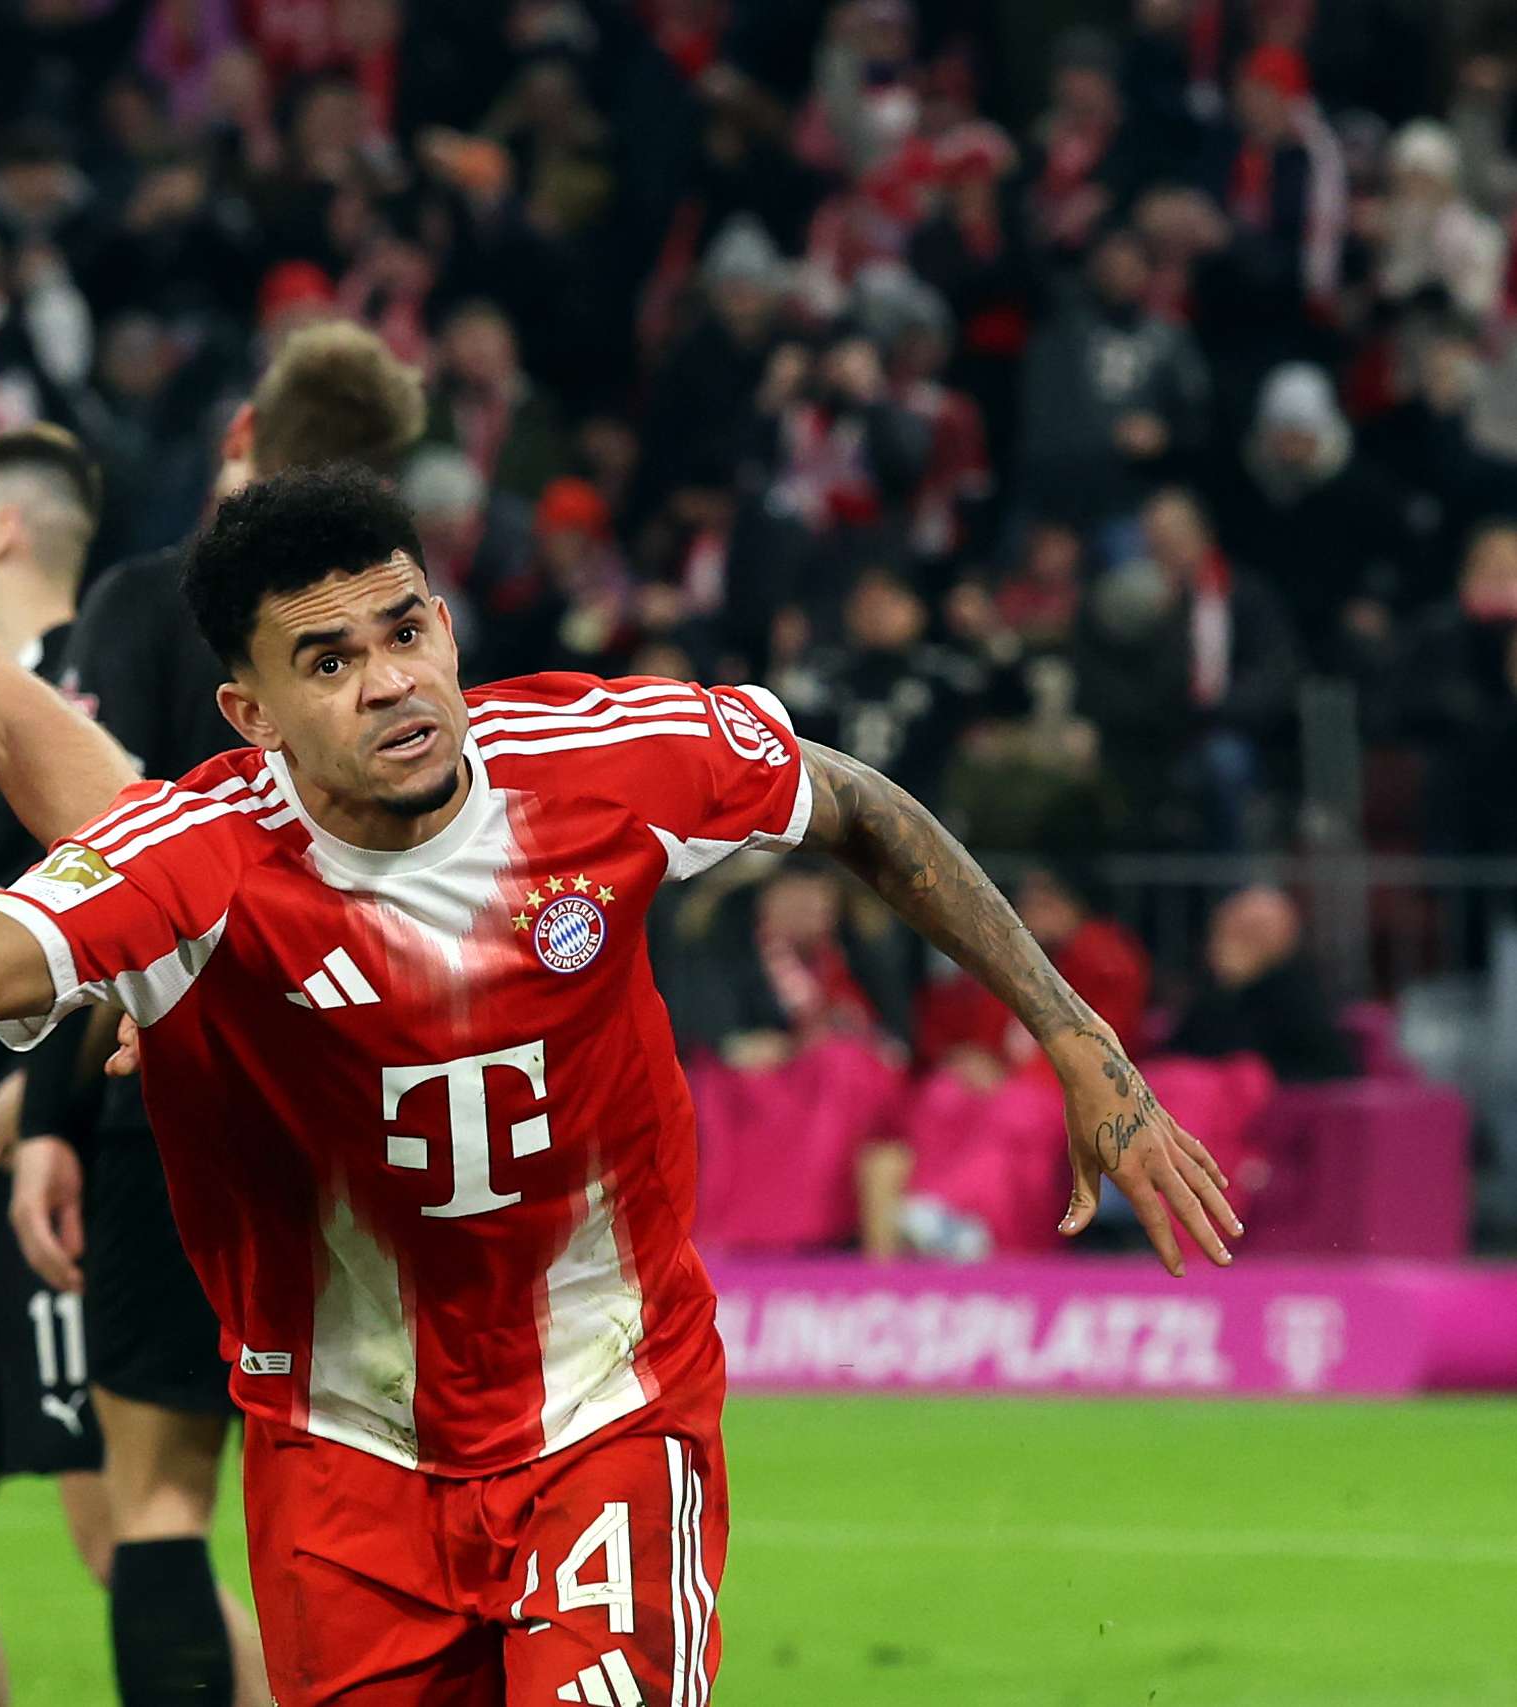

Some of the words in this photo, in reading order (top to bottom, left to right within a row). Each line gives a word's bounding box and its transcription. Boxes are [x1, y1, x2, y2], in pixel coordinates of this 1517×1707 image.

[539, 919, 552, 938] FC
[548, 901, 597, 923] BAYERN
[381, 1039, 552, 1218] T
[28, 1290, 88, 1387] 11
